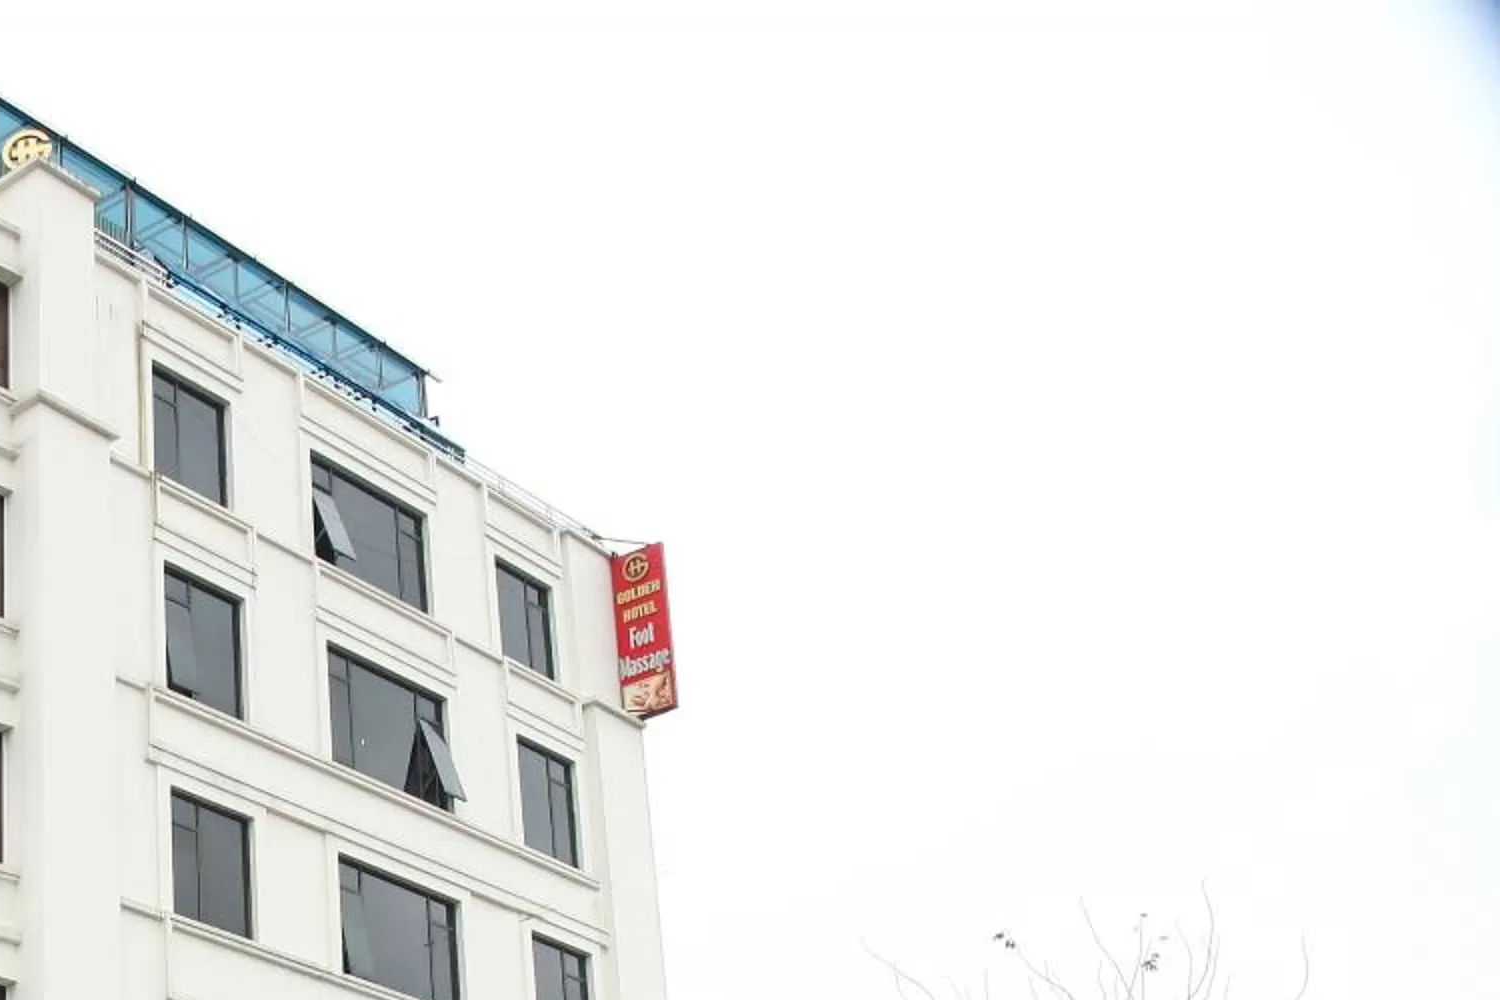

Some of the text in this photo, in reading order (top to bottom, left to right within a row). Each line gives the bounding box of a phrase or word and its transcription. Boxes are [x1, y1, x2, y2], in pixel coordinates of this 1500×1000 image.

[616, 579, 661, 605] GOLDEN
[623, 600, 659, 623] HOTEL
[628, 622, 655, 648] Foot
[619, 648, 672, 681] Massage
